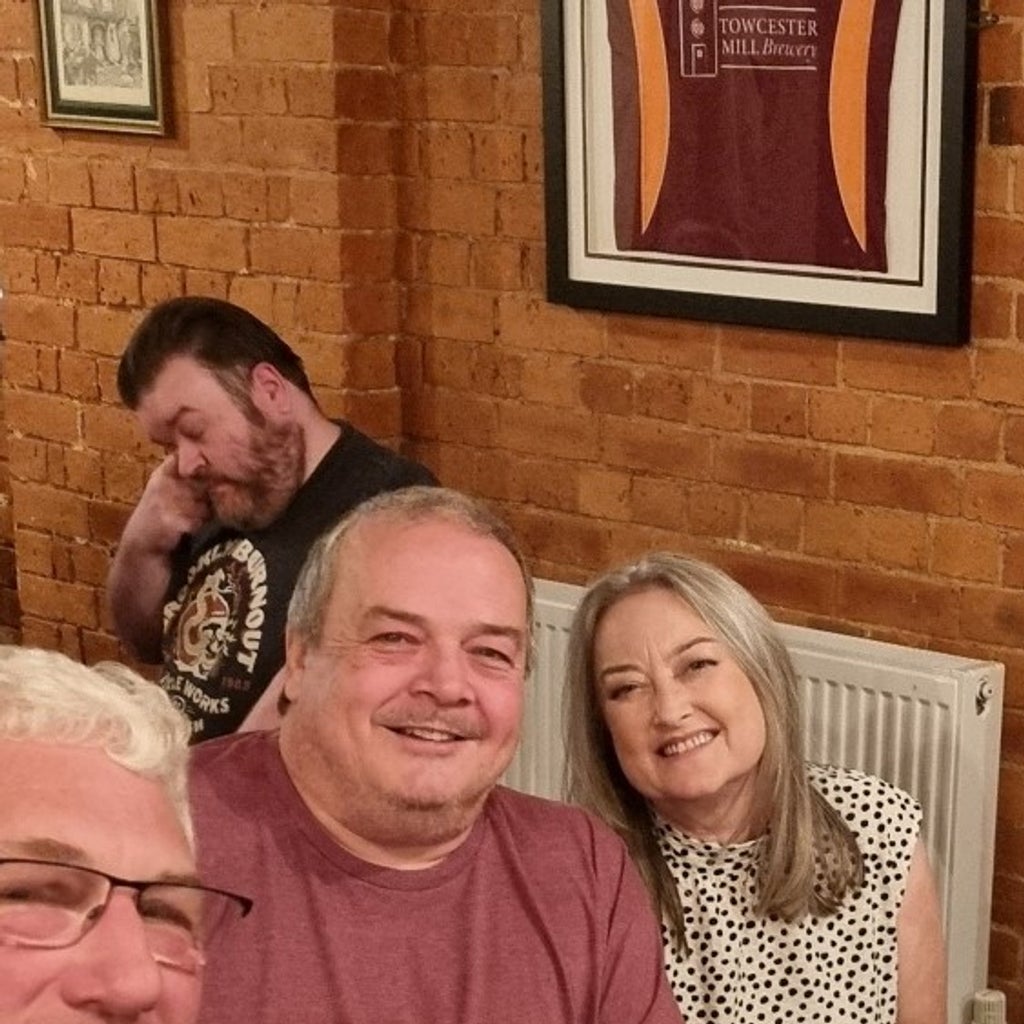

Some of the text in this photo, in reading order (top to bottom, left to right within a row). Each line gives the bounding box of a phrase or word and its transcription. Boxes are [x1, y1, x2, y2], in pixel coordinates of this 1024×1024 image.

[719, 17, 819, 36] TOWCESTER
[721, 37, 817, 61] MILL Brewery
[230, 537, 269, 675] BURNOUT
[183, 679, 231, 714] WORKS
